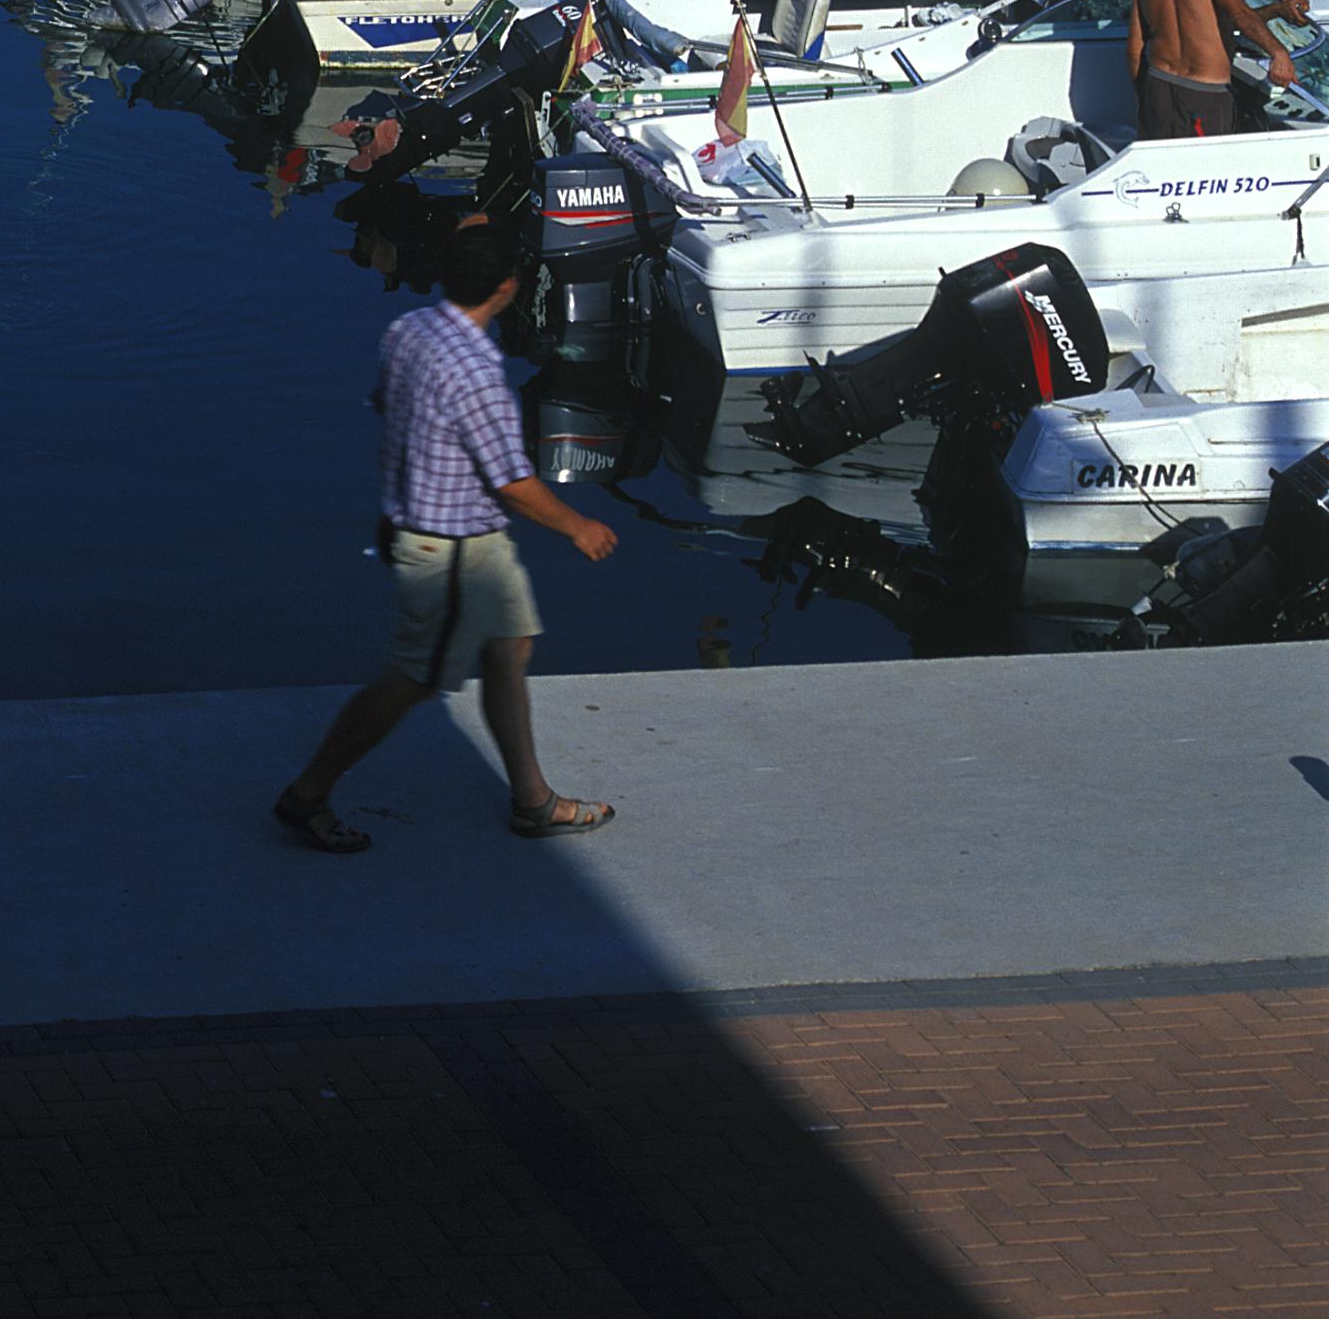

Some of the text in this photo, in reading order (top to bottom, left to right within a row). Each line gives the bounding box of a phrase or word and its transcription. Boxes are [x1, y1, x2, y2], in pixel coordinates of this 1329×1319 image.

[562, 5, 582, 21] 60
[557, 184, 625, 208] YAMAHA
[1160, 177, 1270, 197] DELFIN 520
[1028, 293, 1092, 383] MERCURY
[1077, 463, 1196, 488] CARINA
